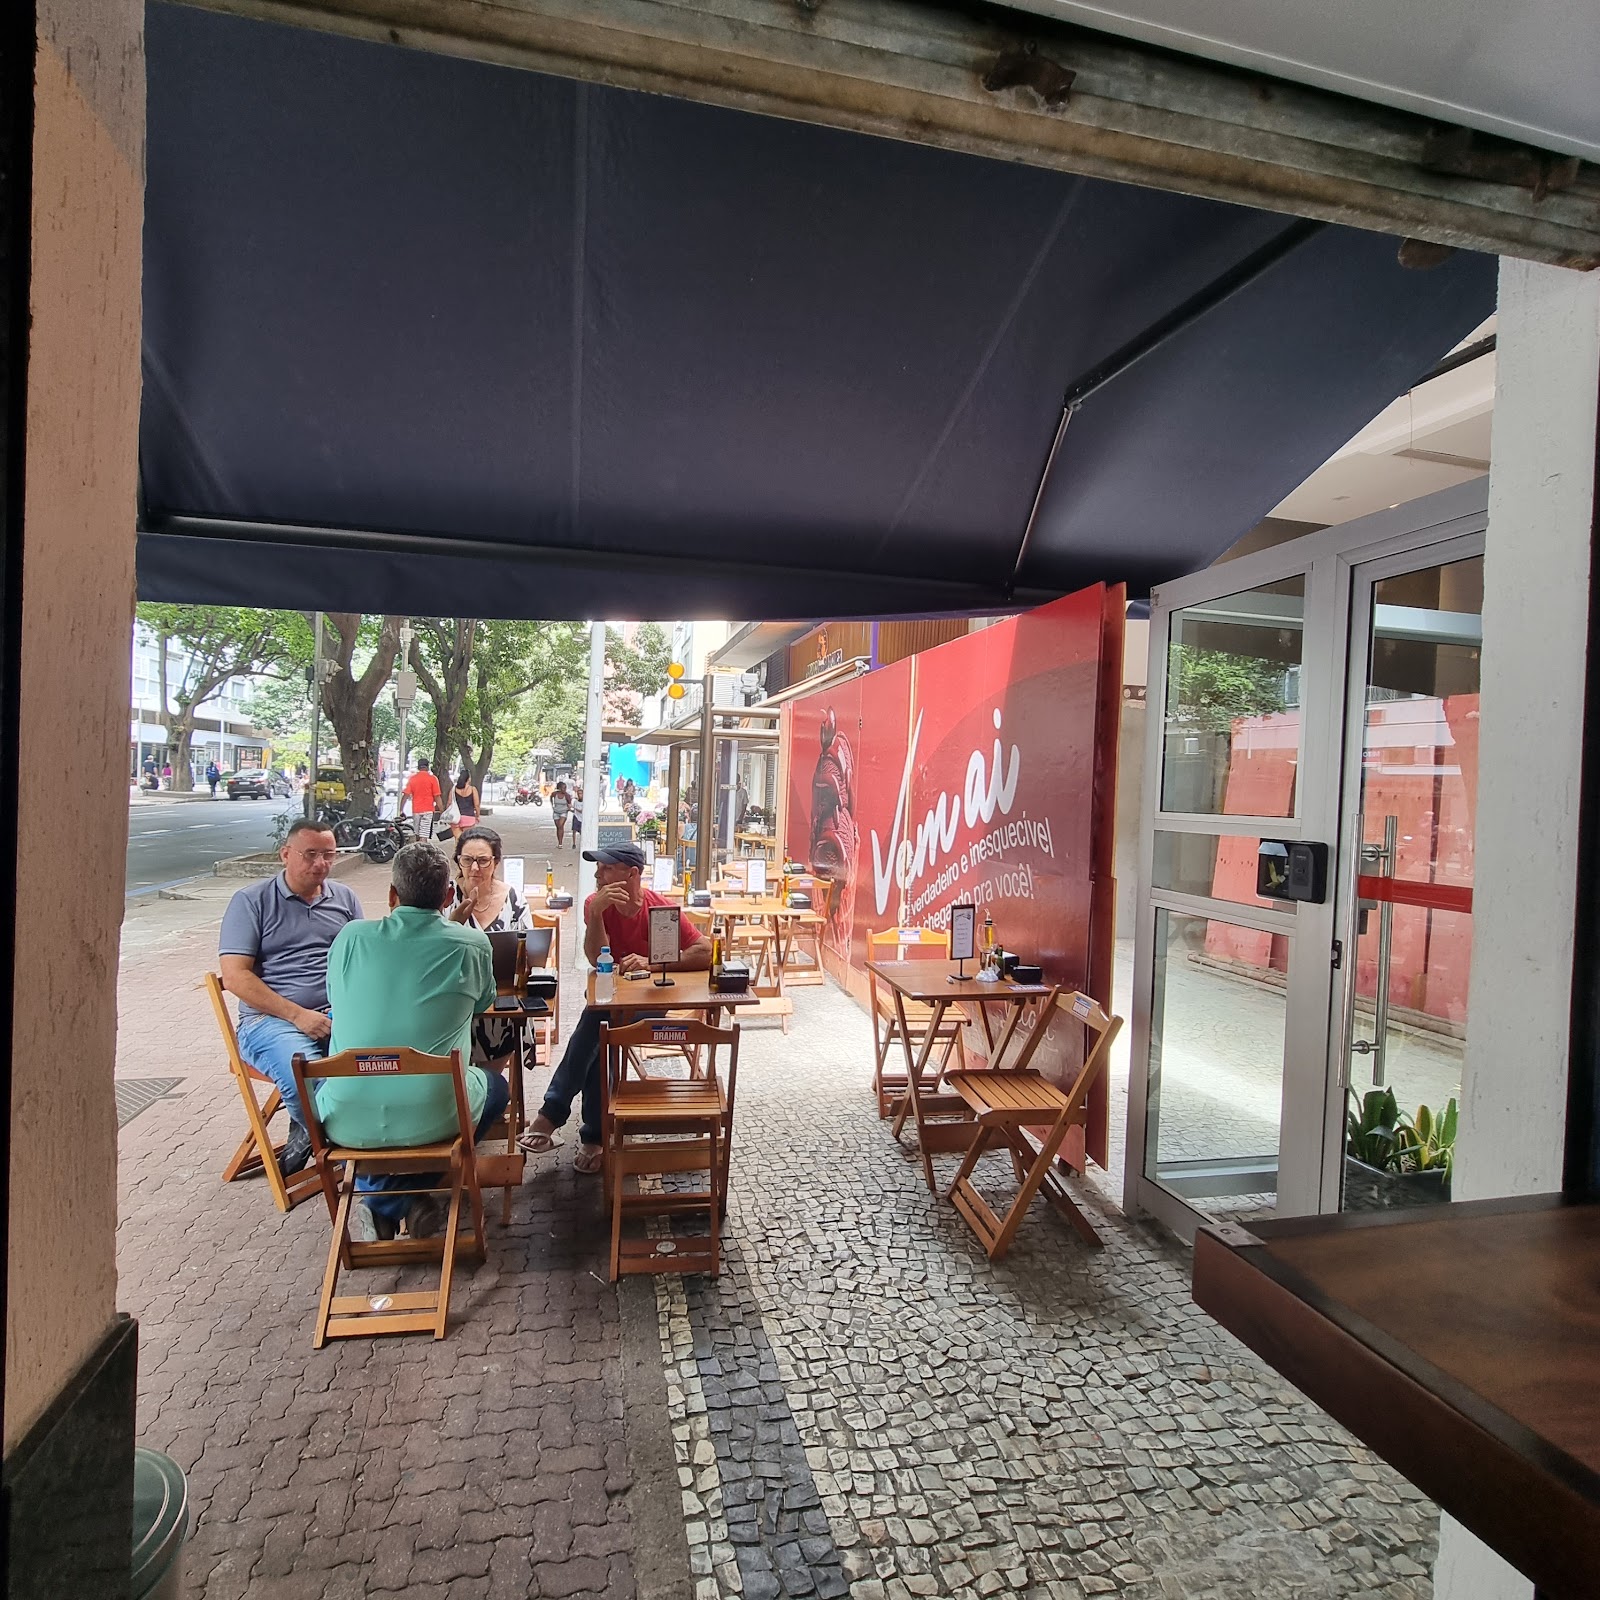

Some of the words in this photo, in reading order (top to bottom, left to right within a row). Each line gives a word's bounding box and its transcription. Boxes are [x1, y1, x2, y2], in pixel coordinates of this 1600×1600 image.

[870, 706, 961, 916] Vem
[911, 861, 959, 916] verdadeiro
[961, 853, 969, 874] e
[969, 810, 1055, 868] inesquecível
[973, 878, 994, 914] pra
[996, 863, 1035, 900] você!
[653, 1031, 687, 1041] BRAHMA
[358, 1061, 399, 1071] BRAHMA
